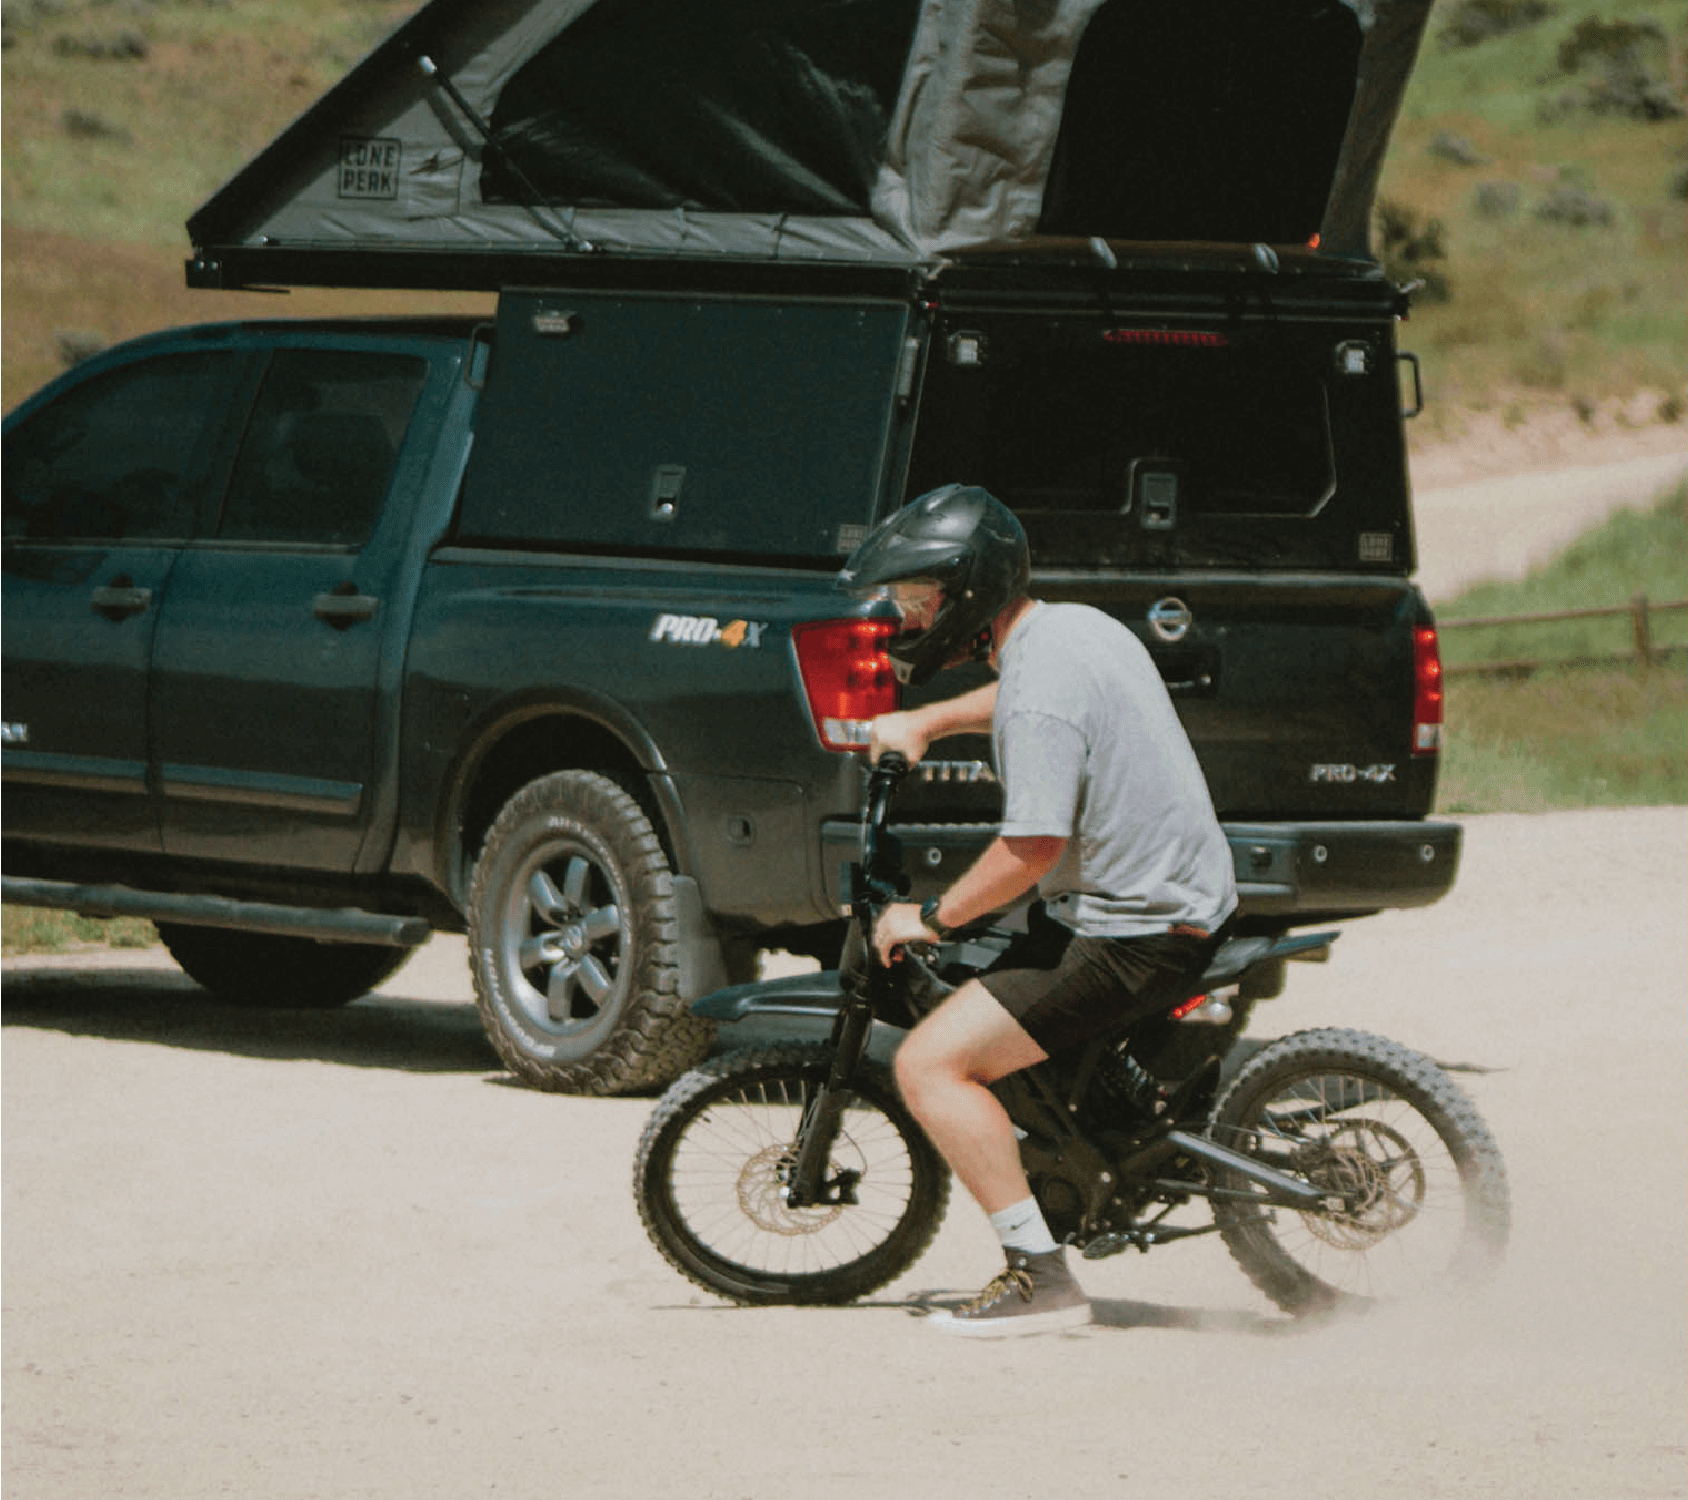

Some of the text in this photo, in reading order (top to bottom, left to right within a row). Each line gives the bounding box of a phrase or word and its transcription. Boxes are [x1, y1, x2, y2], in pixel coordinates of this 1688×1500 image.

[343, 169, 392, 191] PEAK
[917, 761, 998, 782] TITA
[1309, 763, 1397, 783] PRO-4X
